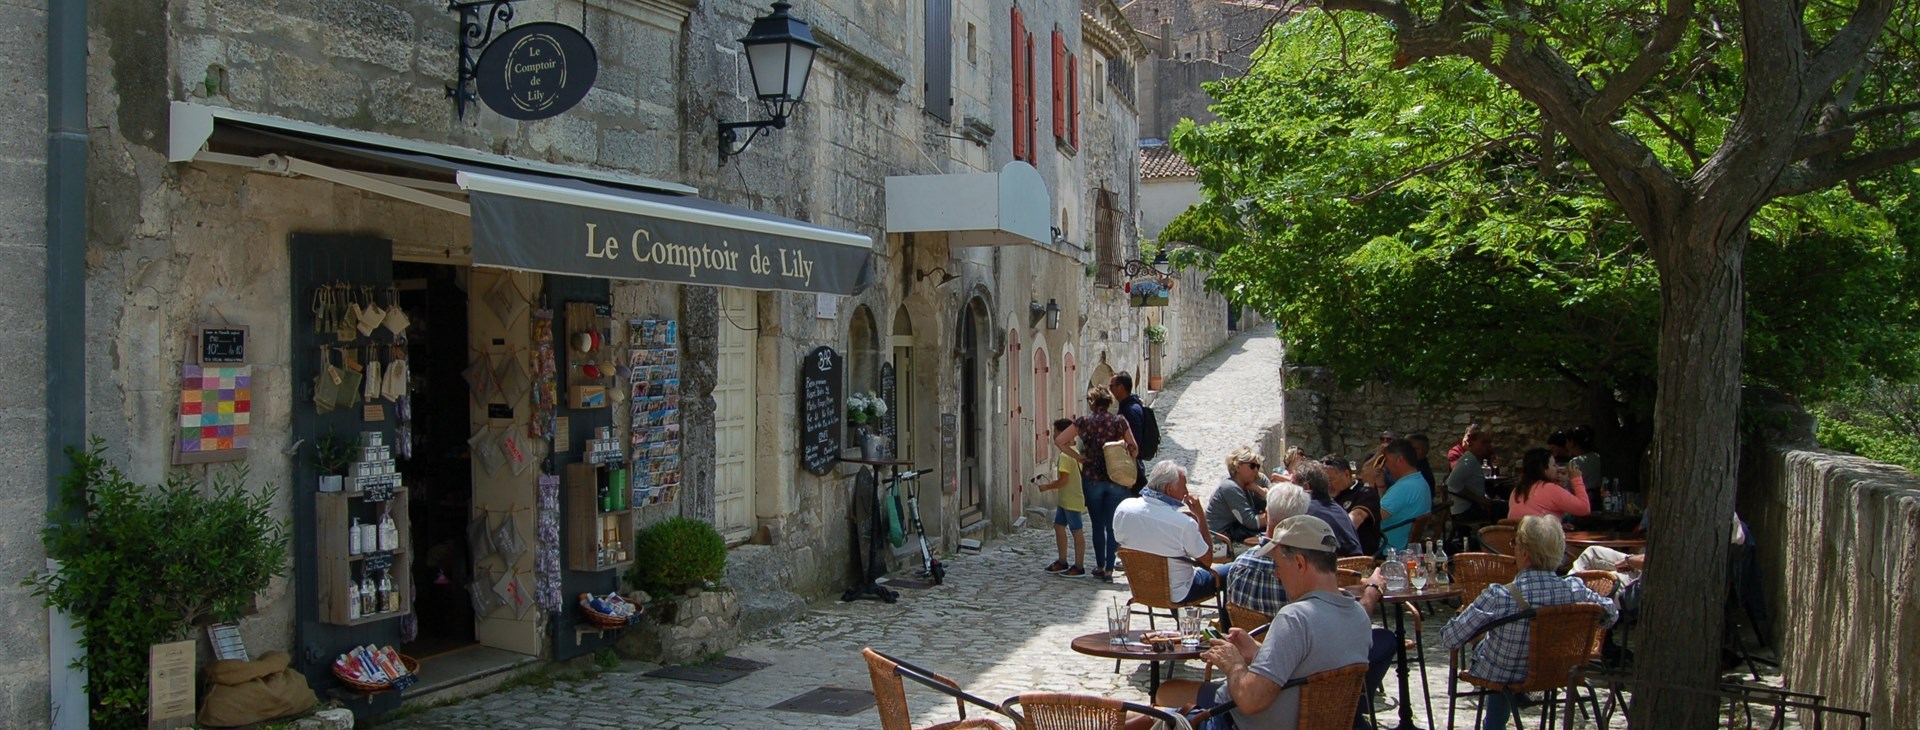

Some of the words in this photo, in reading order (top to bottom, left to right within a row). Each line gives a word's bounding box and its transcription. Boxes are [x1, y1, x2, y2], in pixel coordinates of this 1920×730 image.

[529, 47, 540, 57] Le
[514, 58, 556, 74] Comptoir
[530, 76, 540, 86] de
[528, 91, 544, 102] Lily
[586, 223, 619, 260] Le
[631, 230, 738, 278] Comptoir
[750, 244, 771, 275] de
[781, 248, 814, 287] Lily
[818, 349, 832, 370] BAR
